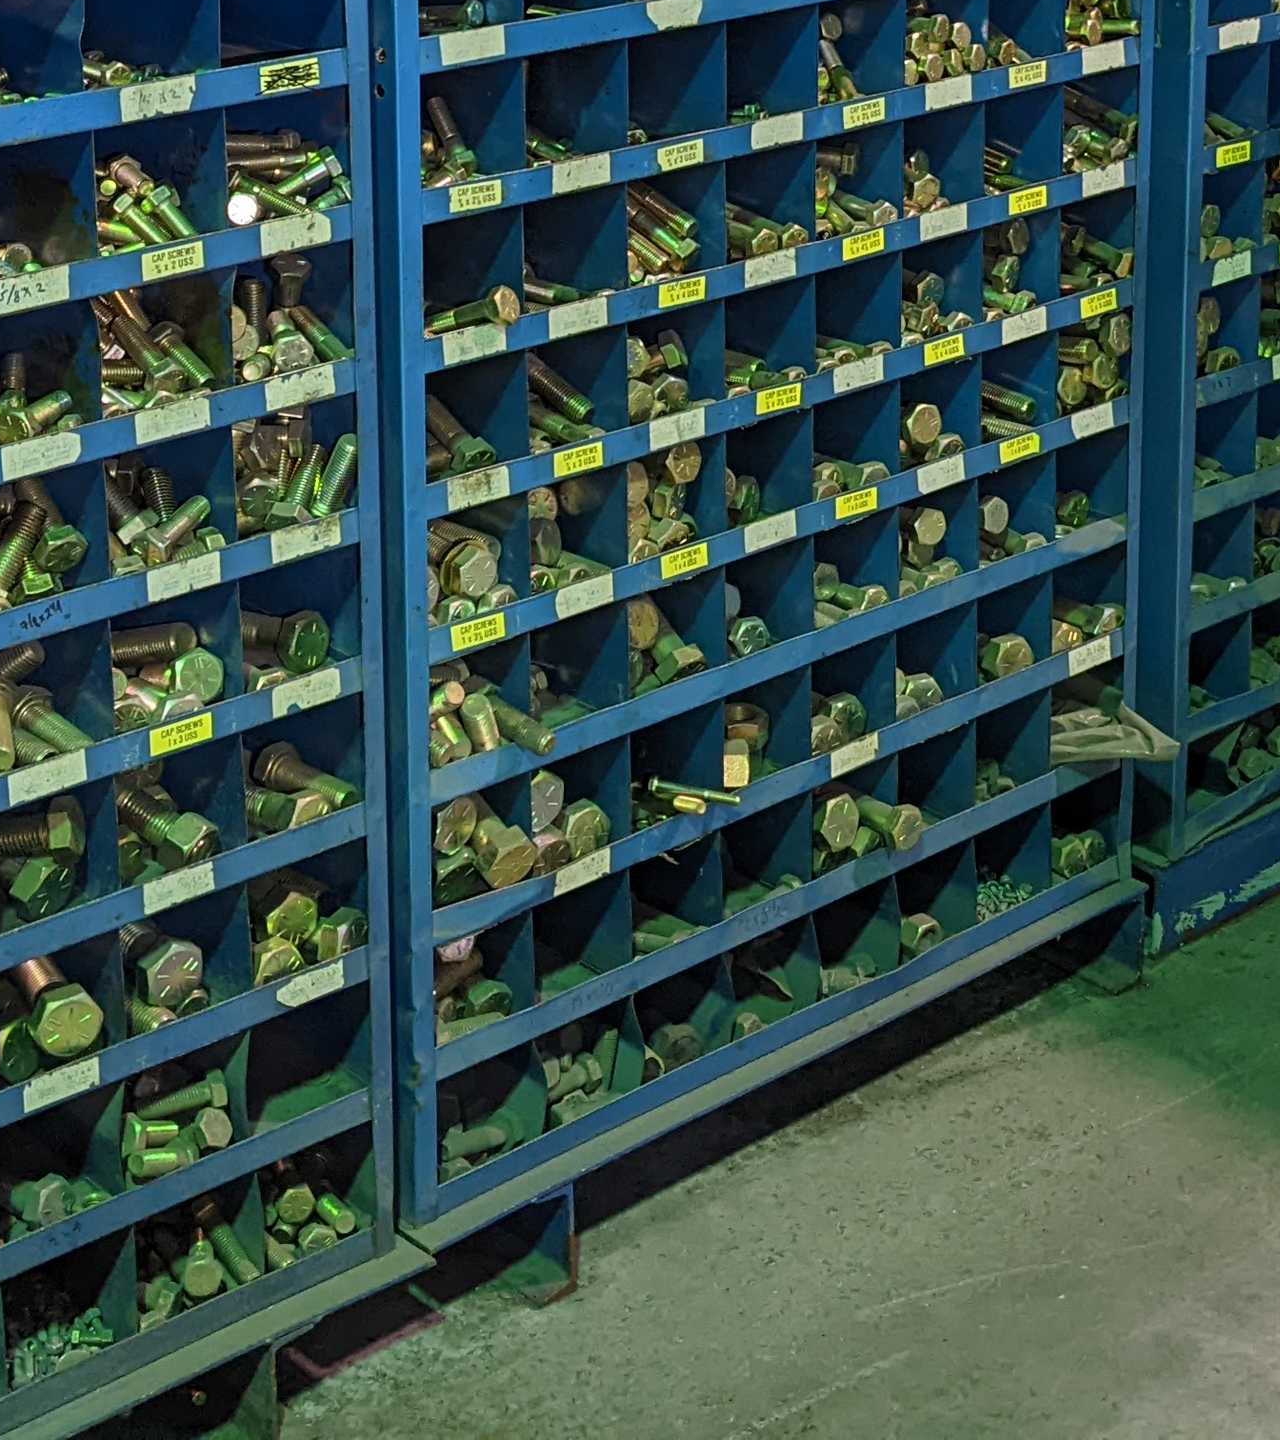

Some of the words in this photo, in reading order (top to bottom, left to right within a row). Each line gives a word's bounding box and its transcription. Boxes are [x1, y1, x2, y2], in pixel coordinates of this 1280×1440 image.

[664, 147, 676, 157] CAP
[676, 143, 698, 155] SCREWS
[457, 186, 470, 197] CAP
[471, 184, 495, 195] SCREWS
[151, 252, 166, 263] CAP
[167, 246, 196, 259] SCREWS
[178, 257, 194, 268] USS
[0, 282, 20, 305] 5/8
[36, 282, 46, 294] 2
[562, 451, 575, 462] CAP
[575, 446, 598, 459] SCREWS
[668, 553, 680, 564] CAP
[680, 548, 701, 561] SCREWS
[460, 624, 473, 636] CAP
[473, 619, 497, 632] SCREWS
[161, 727, 175, 739] CAP
[176, 718, 204, 734] SCREWS
[184, 730, 199, 741] USS
